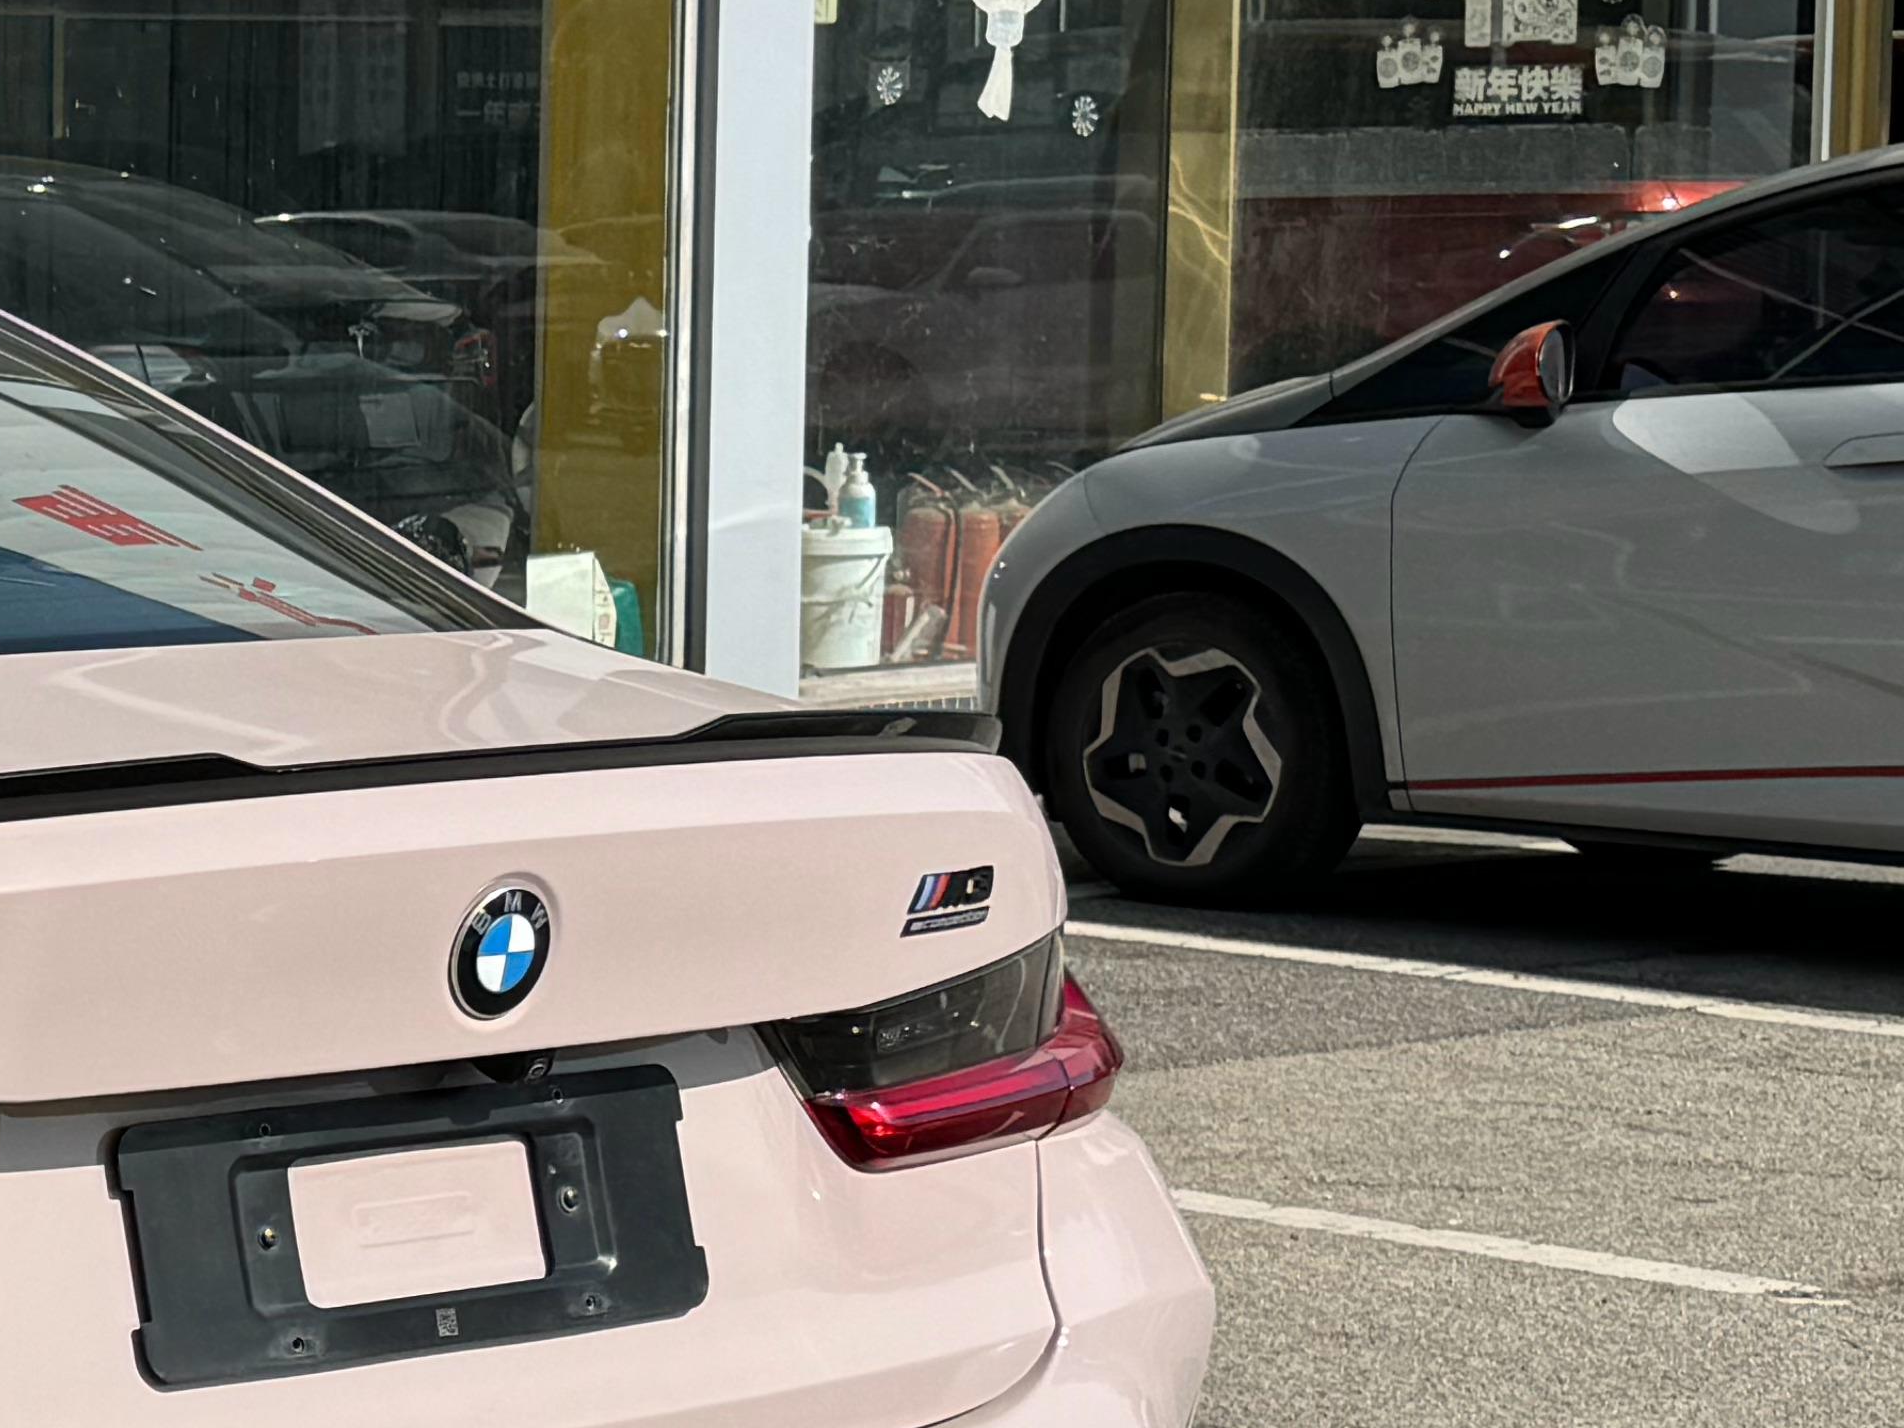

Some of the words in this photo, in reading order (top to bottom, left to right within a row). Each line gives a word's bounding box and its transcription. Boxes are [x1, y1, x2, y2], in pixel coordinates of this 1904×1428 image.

[1454, 65, 1583, 102] 新年快樂
[1452, 102, 1501, 116] HAPPY
[1505, 102, 1539, 115] NEW
[1541, 101, 1583, 115] YEAR
[471, 890, 548, 936] BMW
